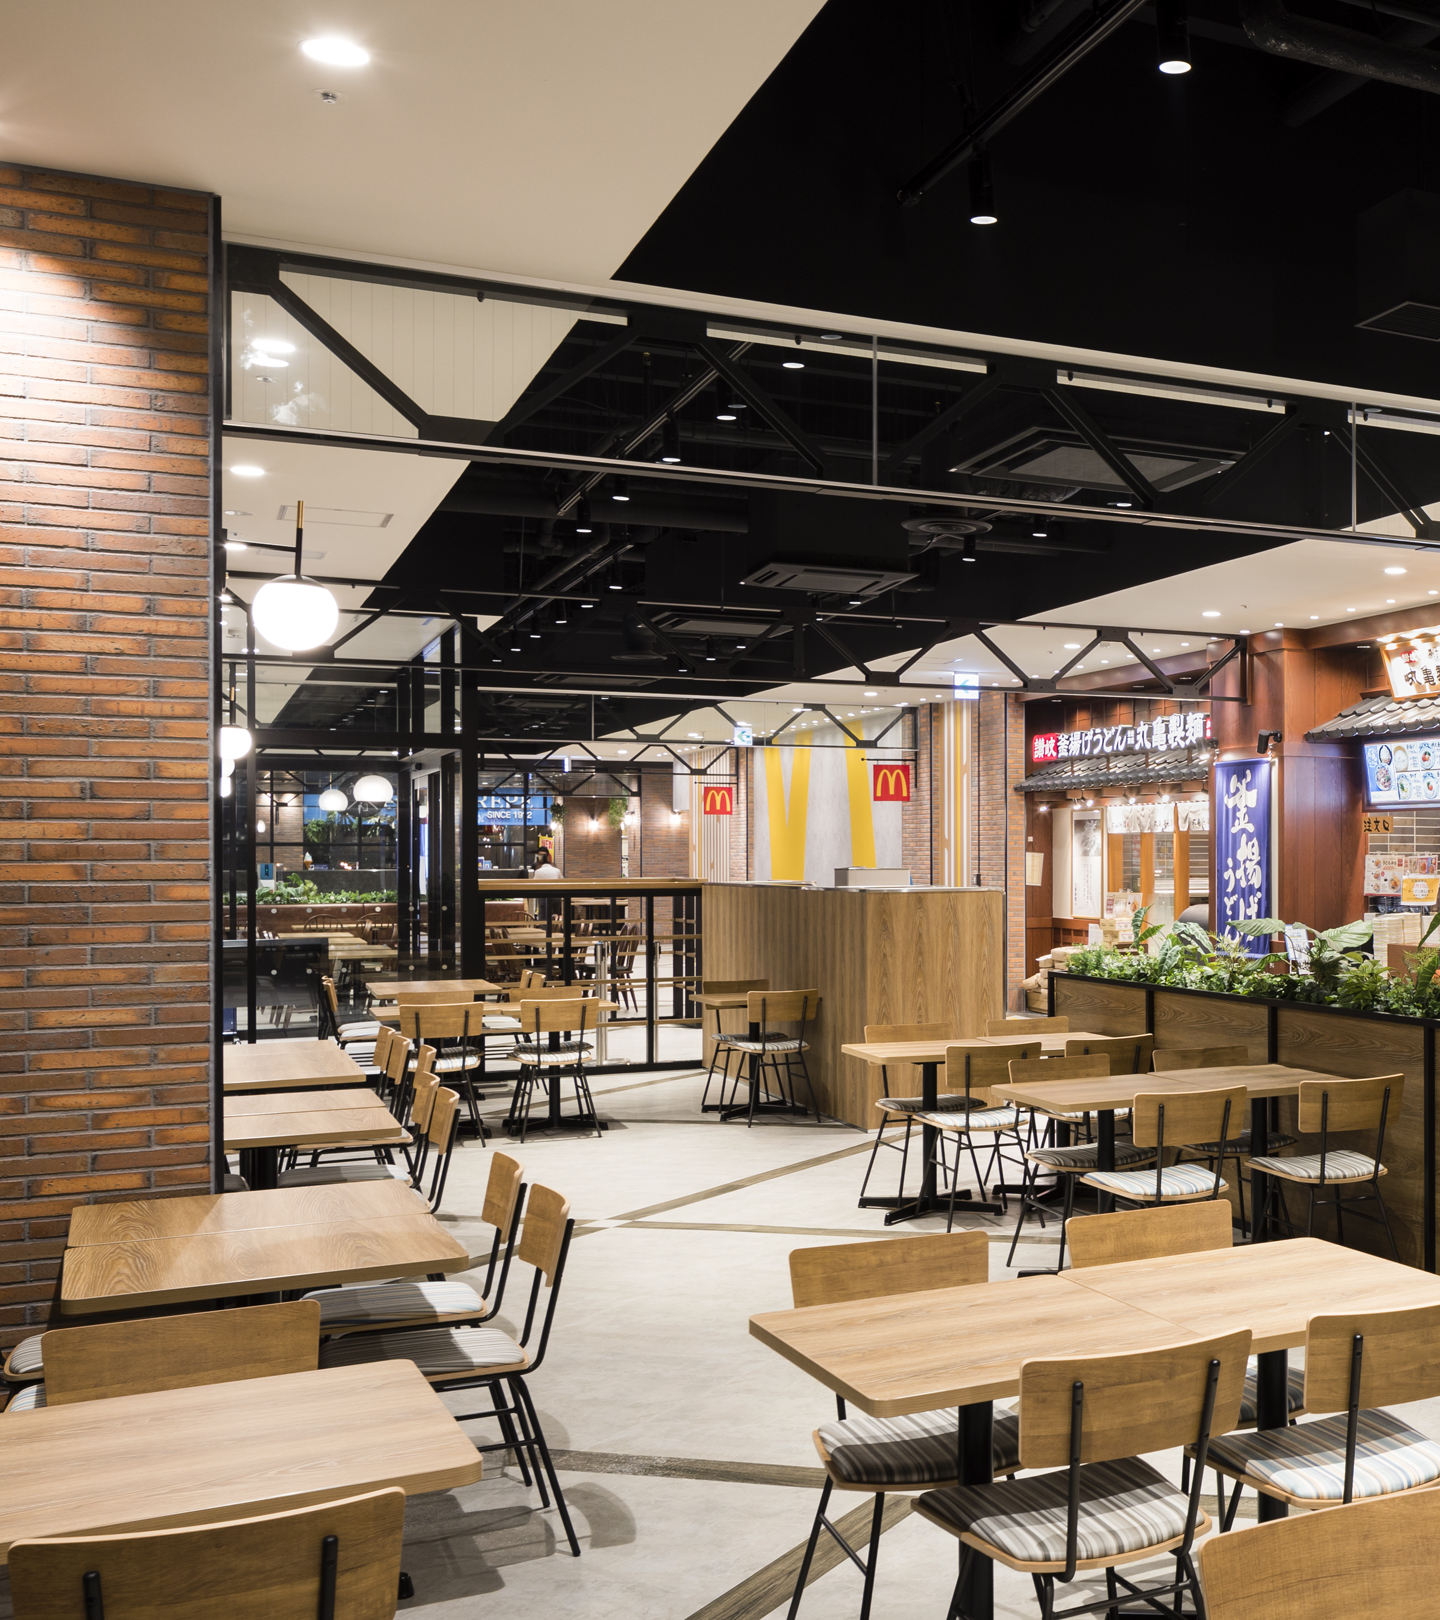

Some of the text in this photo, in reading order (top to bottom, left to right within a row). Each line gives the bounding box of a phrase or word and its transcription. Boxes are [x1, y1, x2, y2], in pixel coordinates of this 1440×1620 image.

[1033, 736, 1057, 759] 讃岐
[1057, 724, 1127, 758] 釜揚げうどん
[1134, 711, 1205, 751] 丸亀製麺
[486, 811, 533, 820] SINCE 192
[1363, 817, 1390, 833] 注文口
